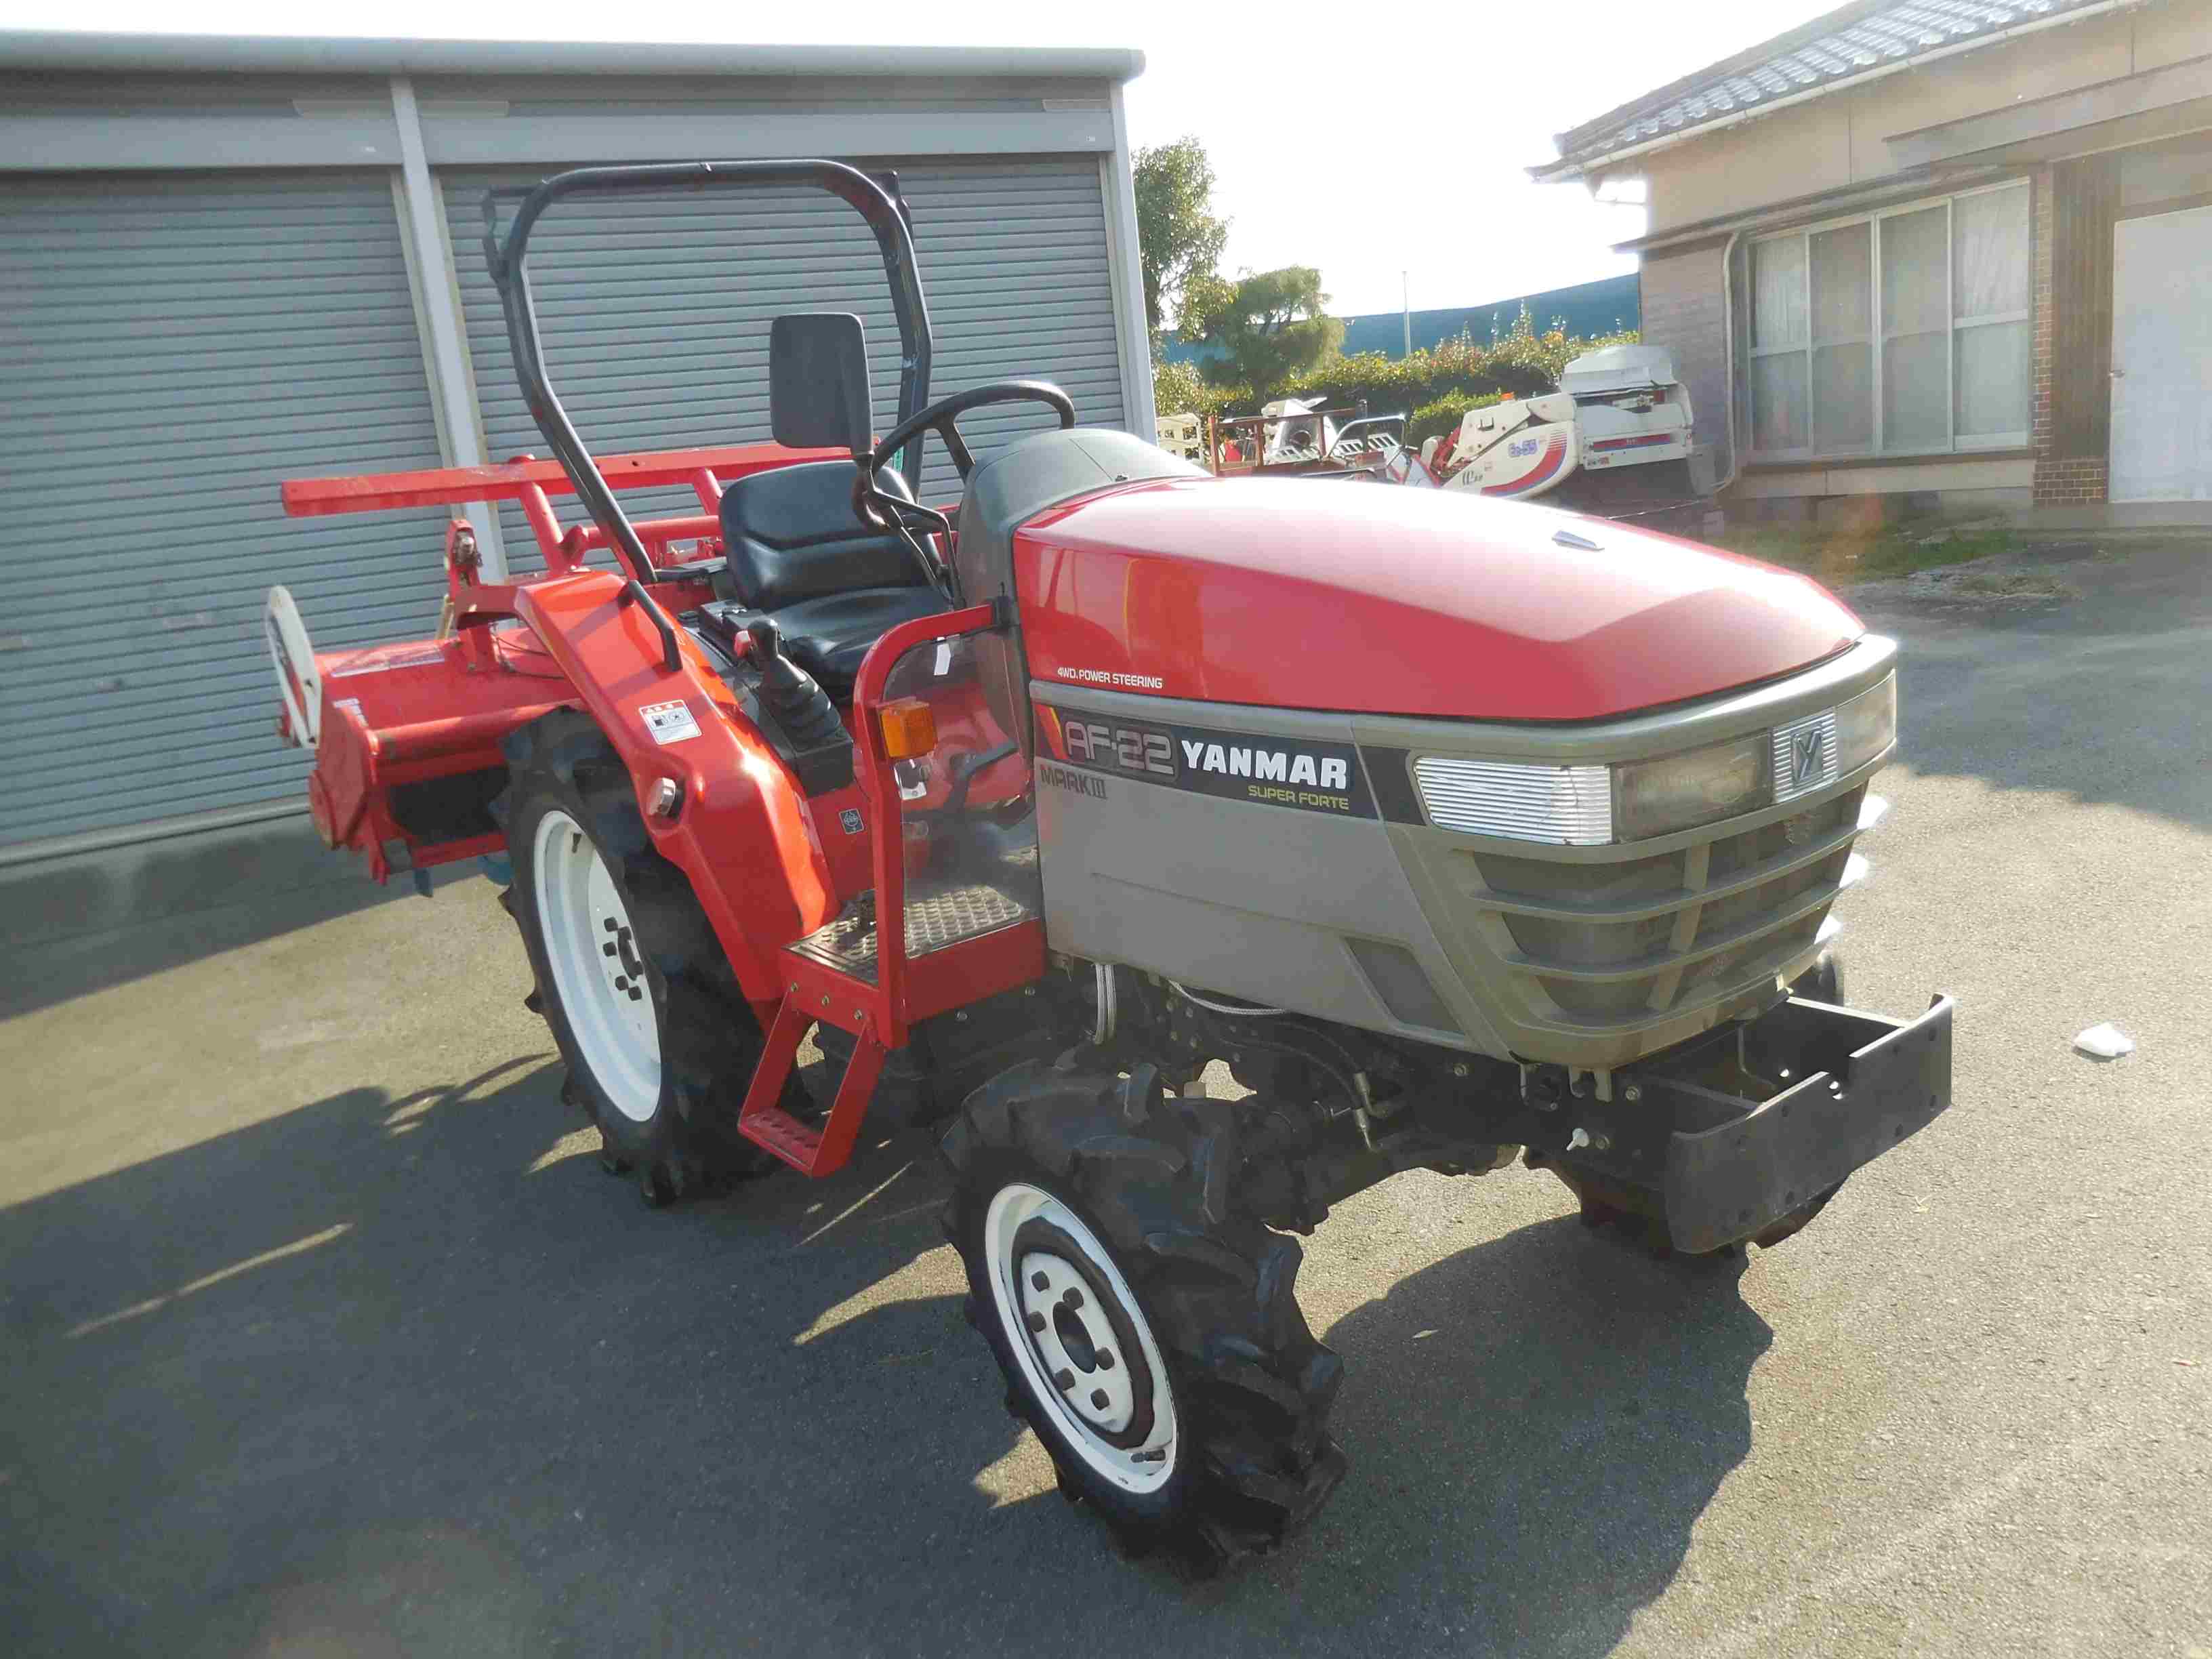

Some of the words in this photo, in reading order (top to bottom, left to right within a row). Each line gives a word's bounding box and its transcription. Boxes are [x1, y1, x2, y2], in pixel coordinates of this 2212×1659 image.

[1112, 673, 1163, 689] STEERING
[1181, 740, 1347, 790] YANMAR
[1248, 785, 1296, 803] SUPER
[1298, 792, 1351, 811] FORTE
